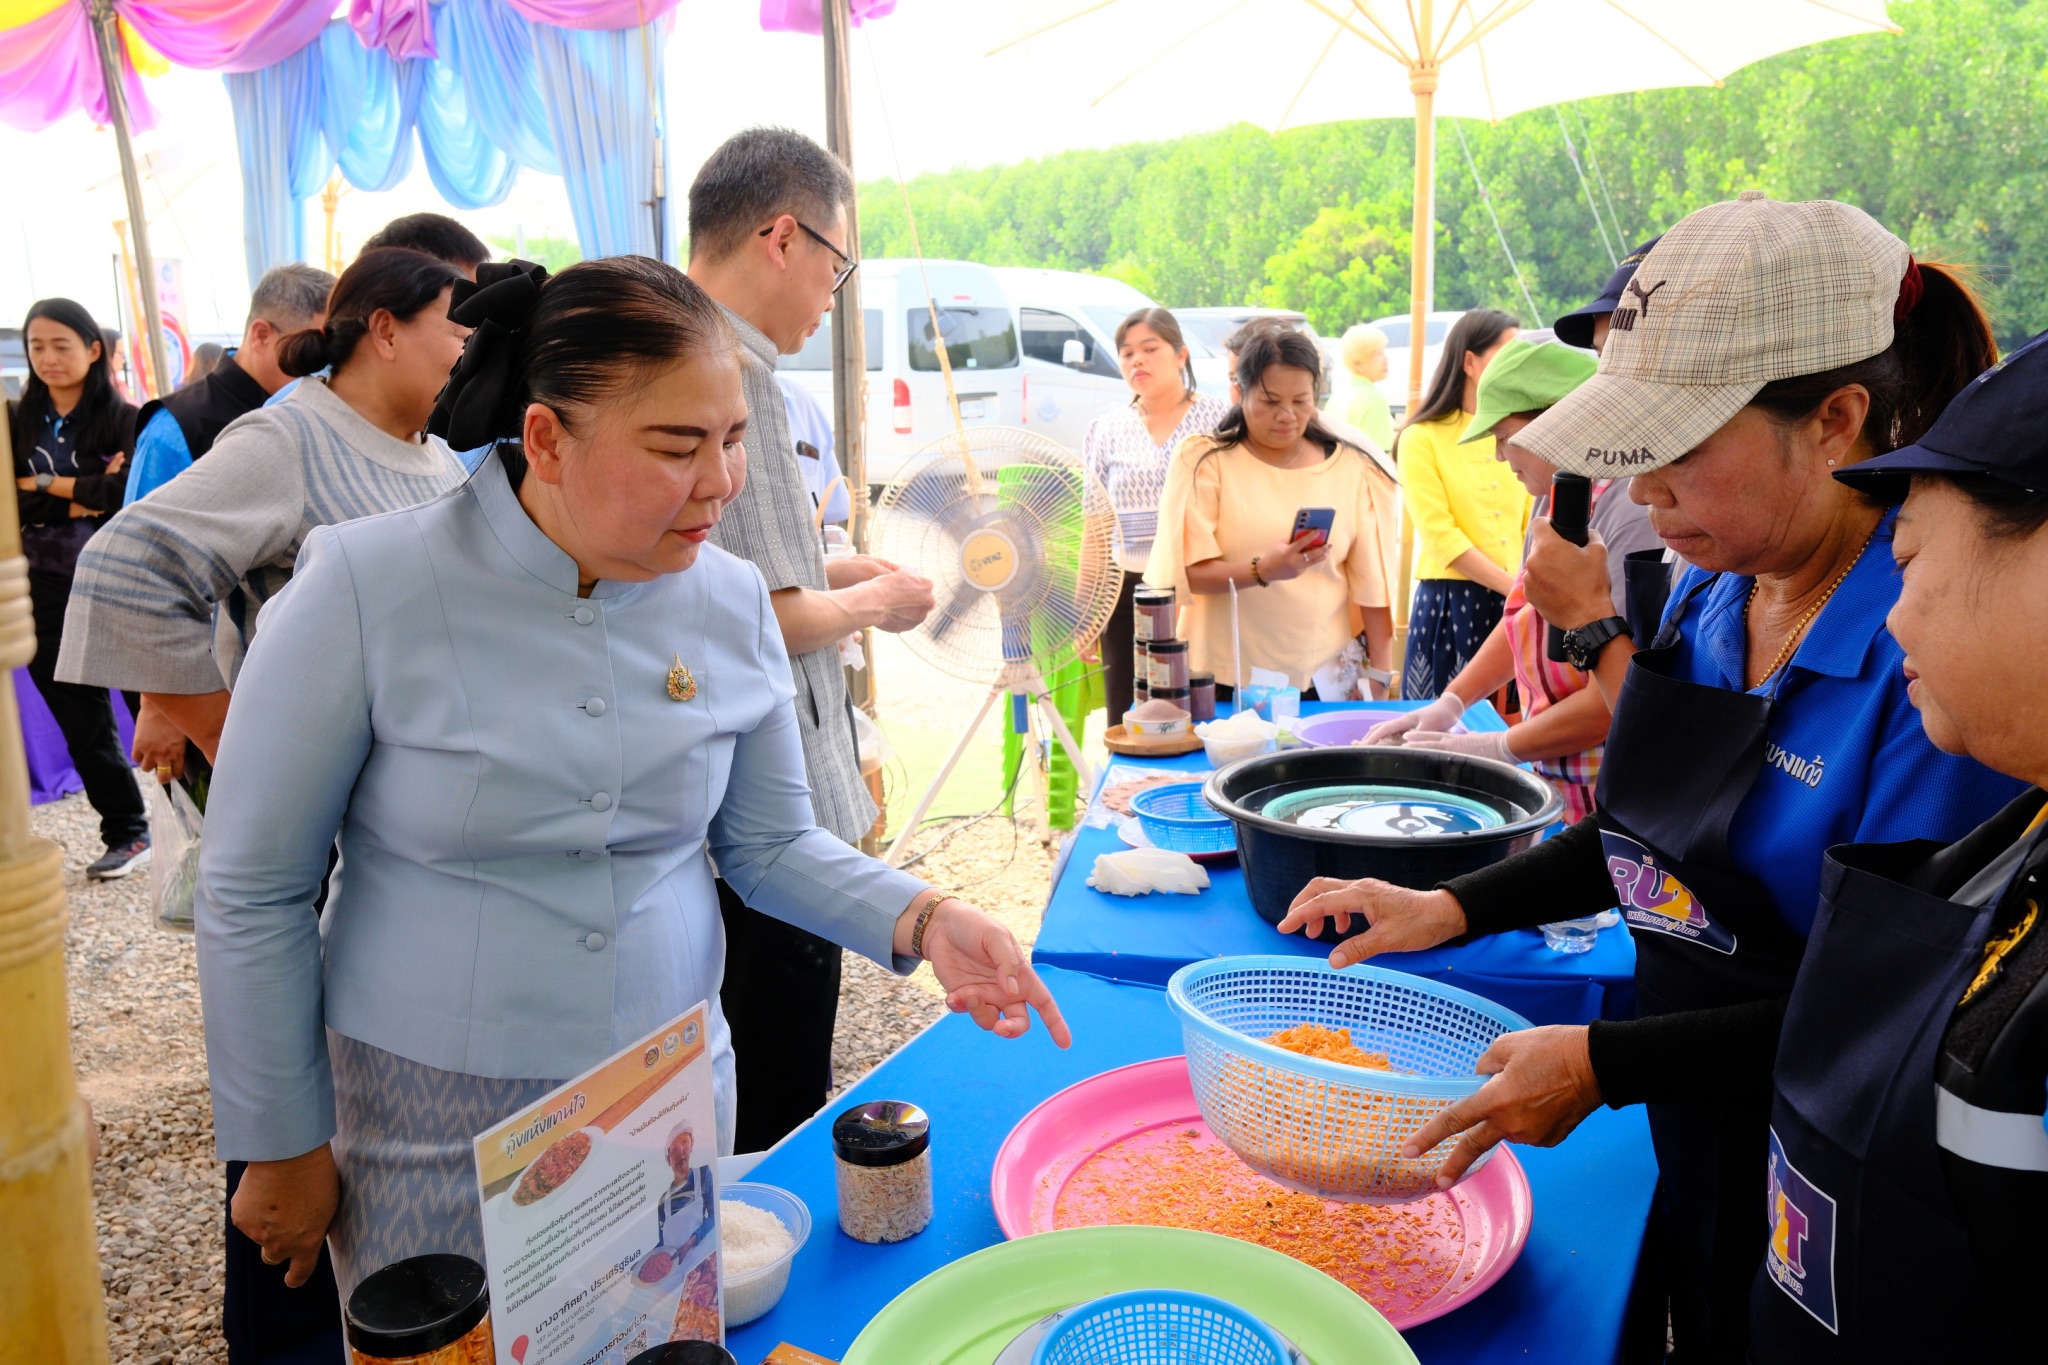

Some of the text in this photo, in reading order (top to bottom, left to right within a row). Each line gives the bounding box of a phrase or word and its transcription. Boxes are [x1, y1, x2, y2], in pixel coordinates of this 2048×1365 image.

[1584, 446, 1656, 466] PUMA
[1765, 740, 1825, 789] บางแก้ว
[506, 1092, 586, 1160] กุ้งแห้งแทนใจ
[577, 1307, 595, 1324] 75000
[532, 1333, 575, 1365] 99-4161308
[582, 1313, 647, 1365] รมการท่องเที่ยว
